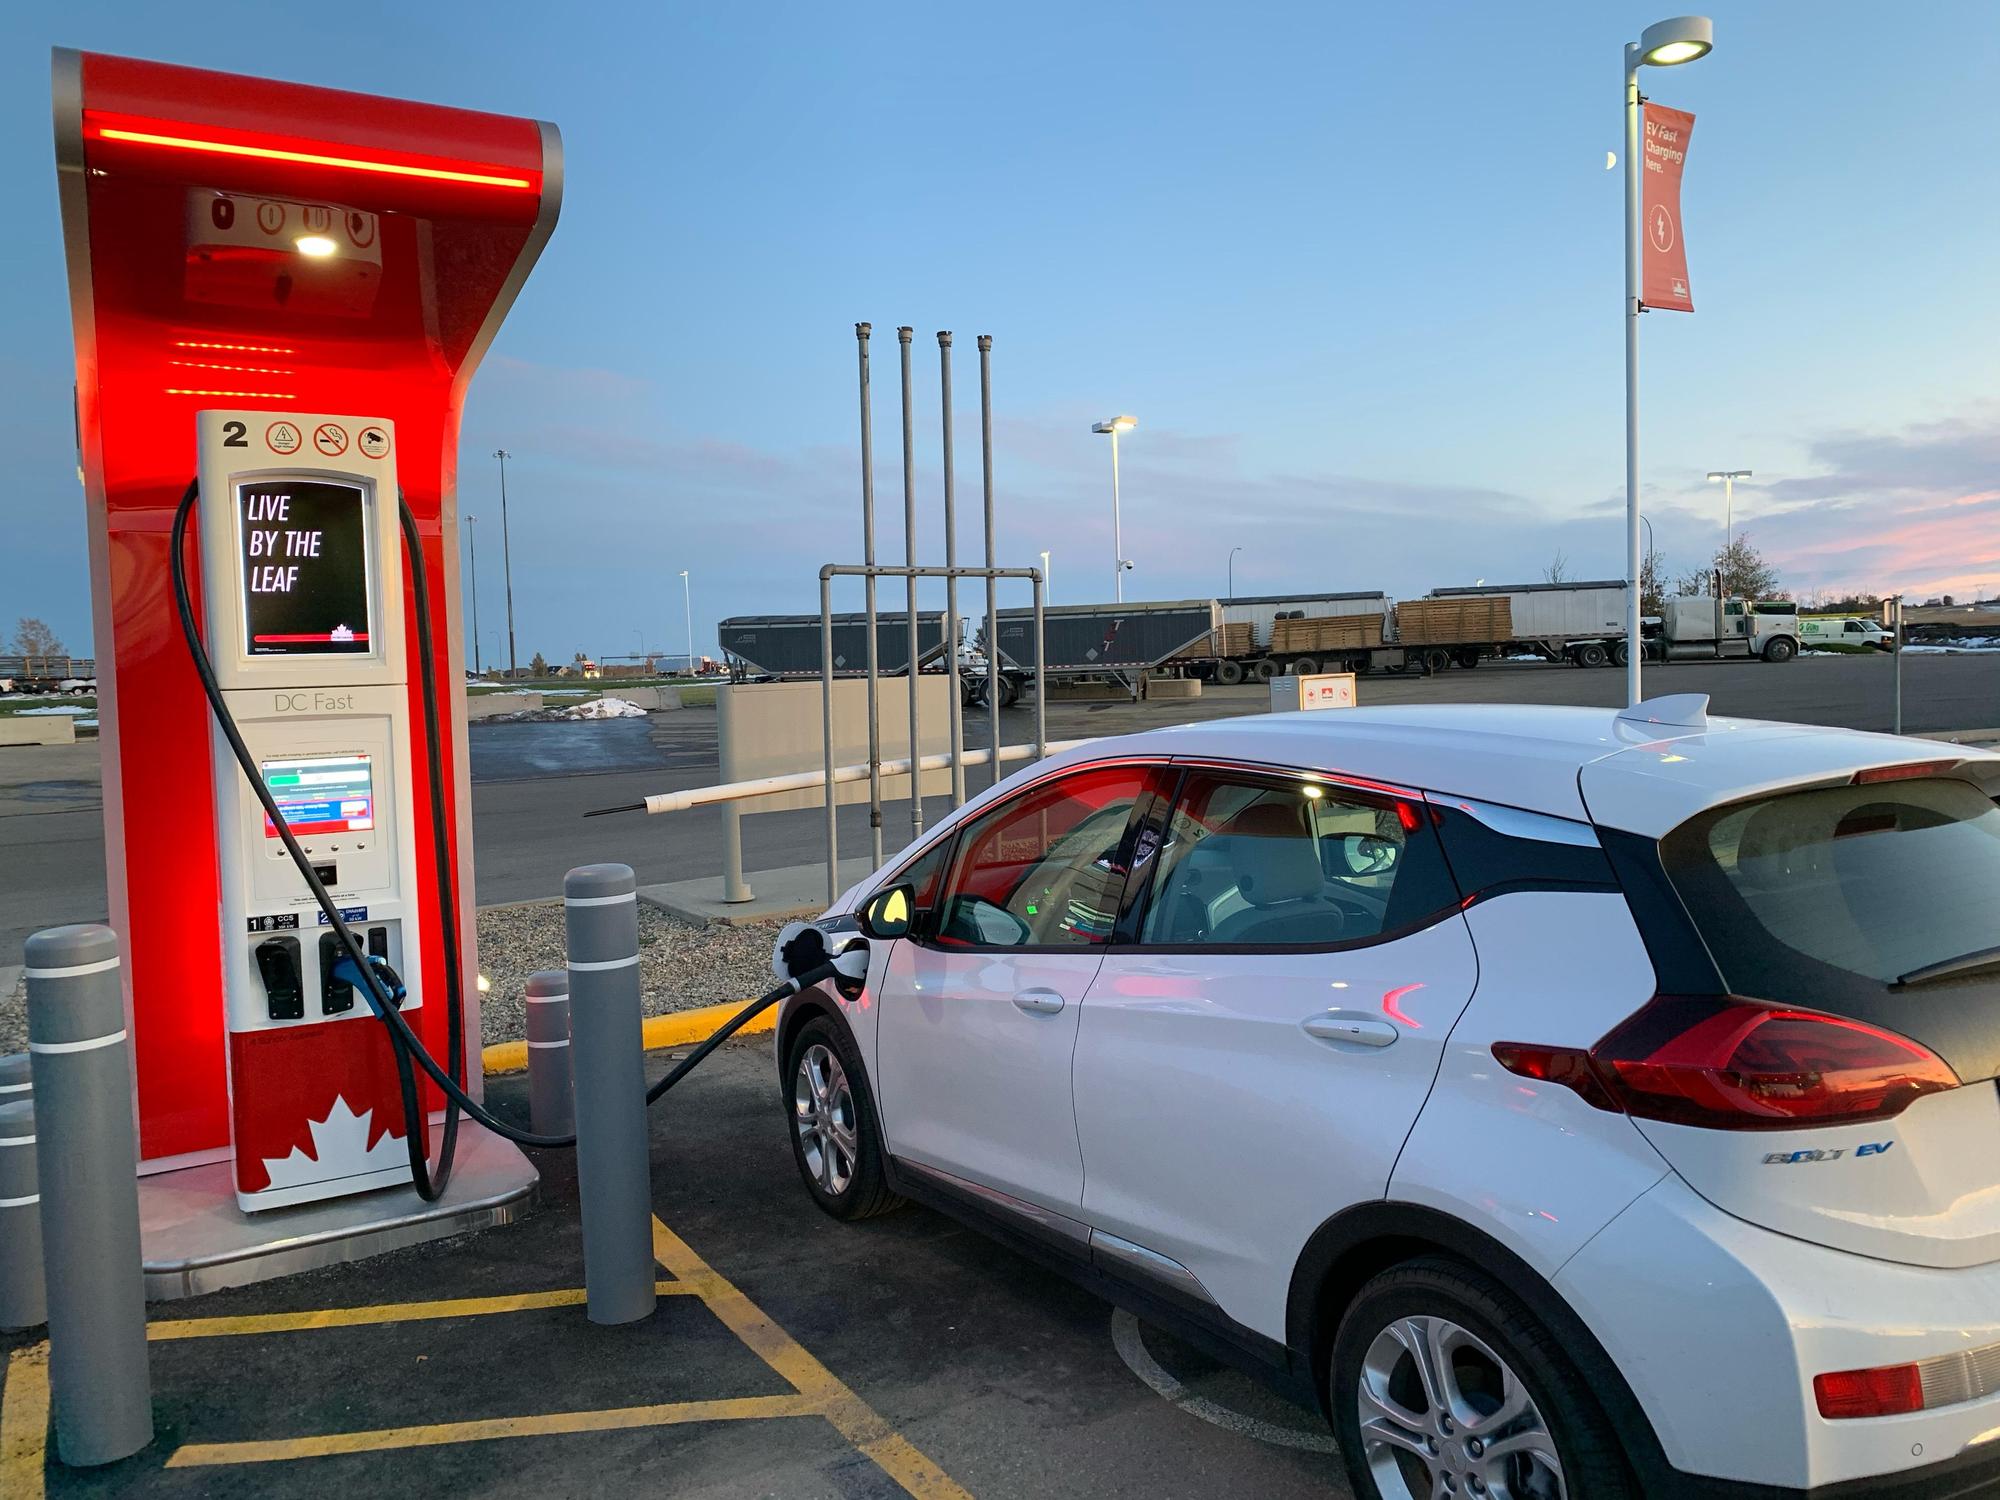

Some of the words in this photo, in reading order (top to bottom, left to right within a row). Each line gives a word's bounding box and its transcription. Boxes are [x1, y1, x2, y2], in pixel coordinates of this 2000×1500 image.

[1646, 121, 1659, 136] EV
[1659, 125, 1678, 142] Fast
[1646, 139, 1683, 164] Charging
[1646, 155, 1664, 174] here.
[223, 421, 249, 447] 2
[248, 495, 291, 521] LIVE
[249, 530, 279, 556] BY
[285, 531, 322, 557] THE
[251, 566, 299, 592] LEAF
[275, 693, 308, 712] DC
[314, 692, 354, 711] Fast
[250, 919, 257, 930] 1
[1855, 1140, 1894, 1157] EV
